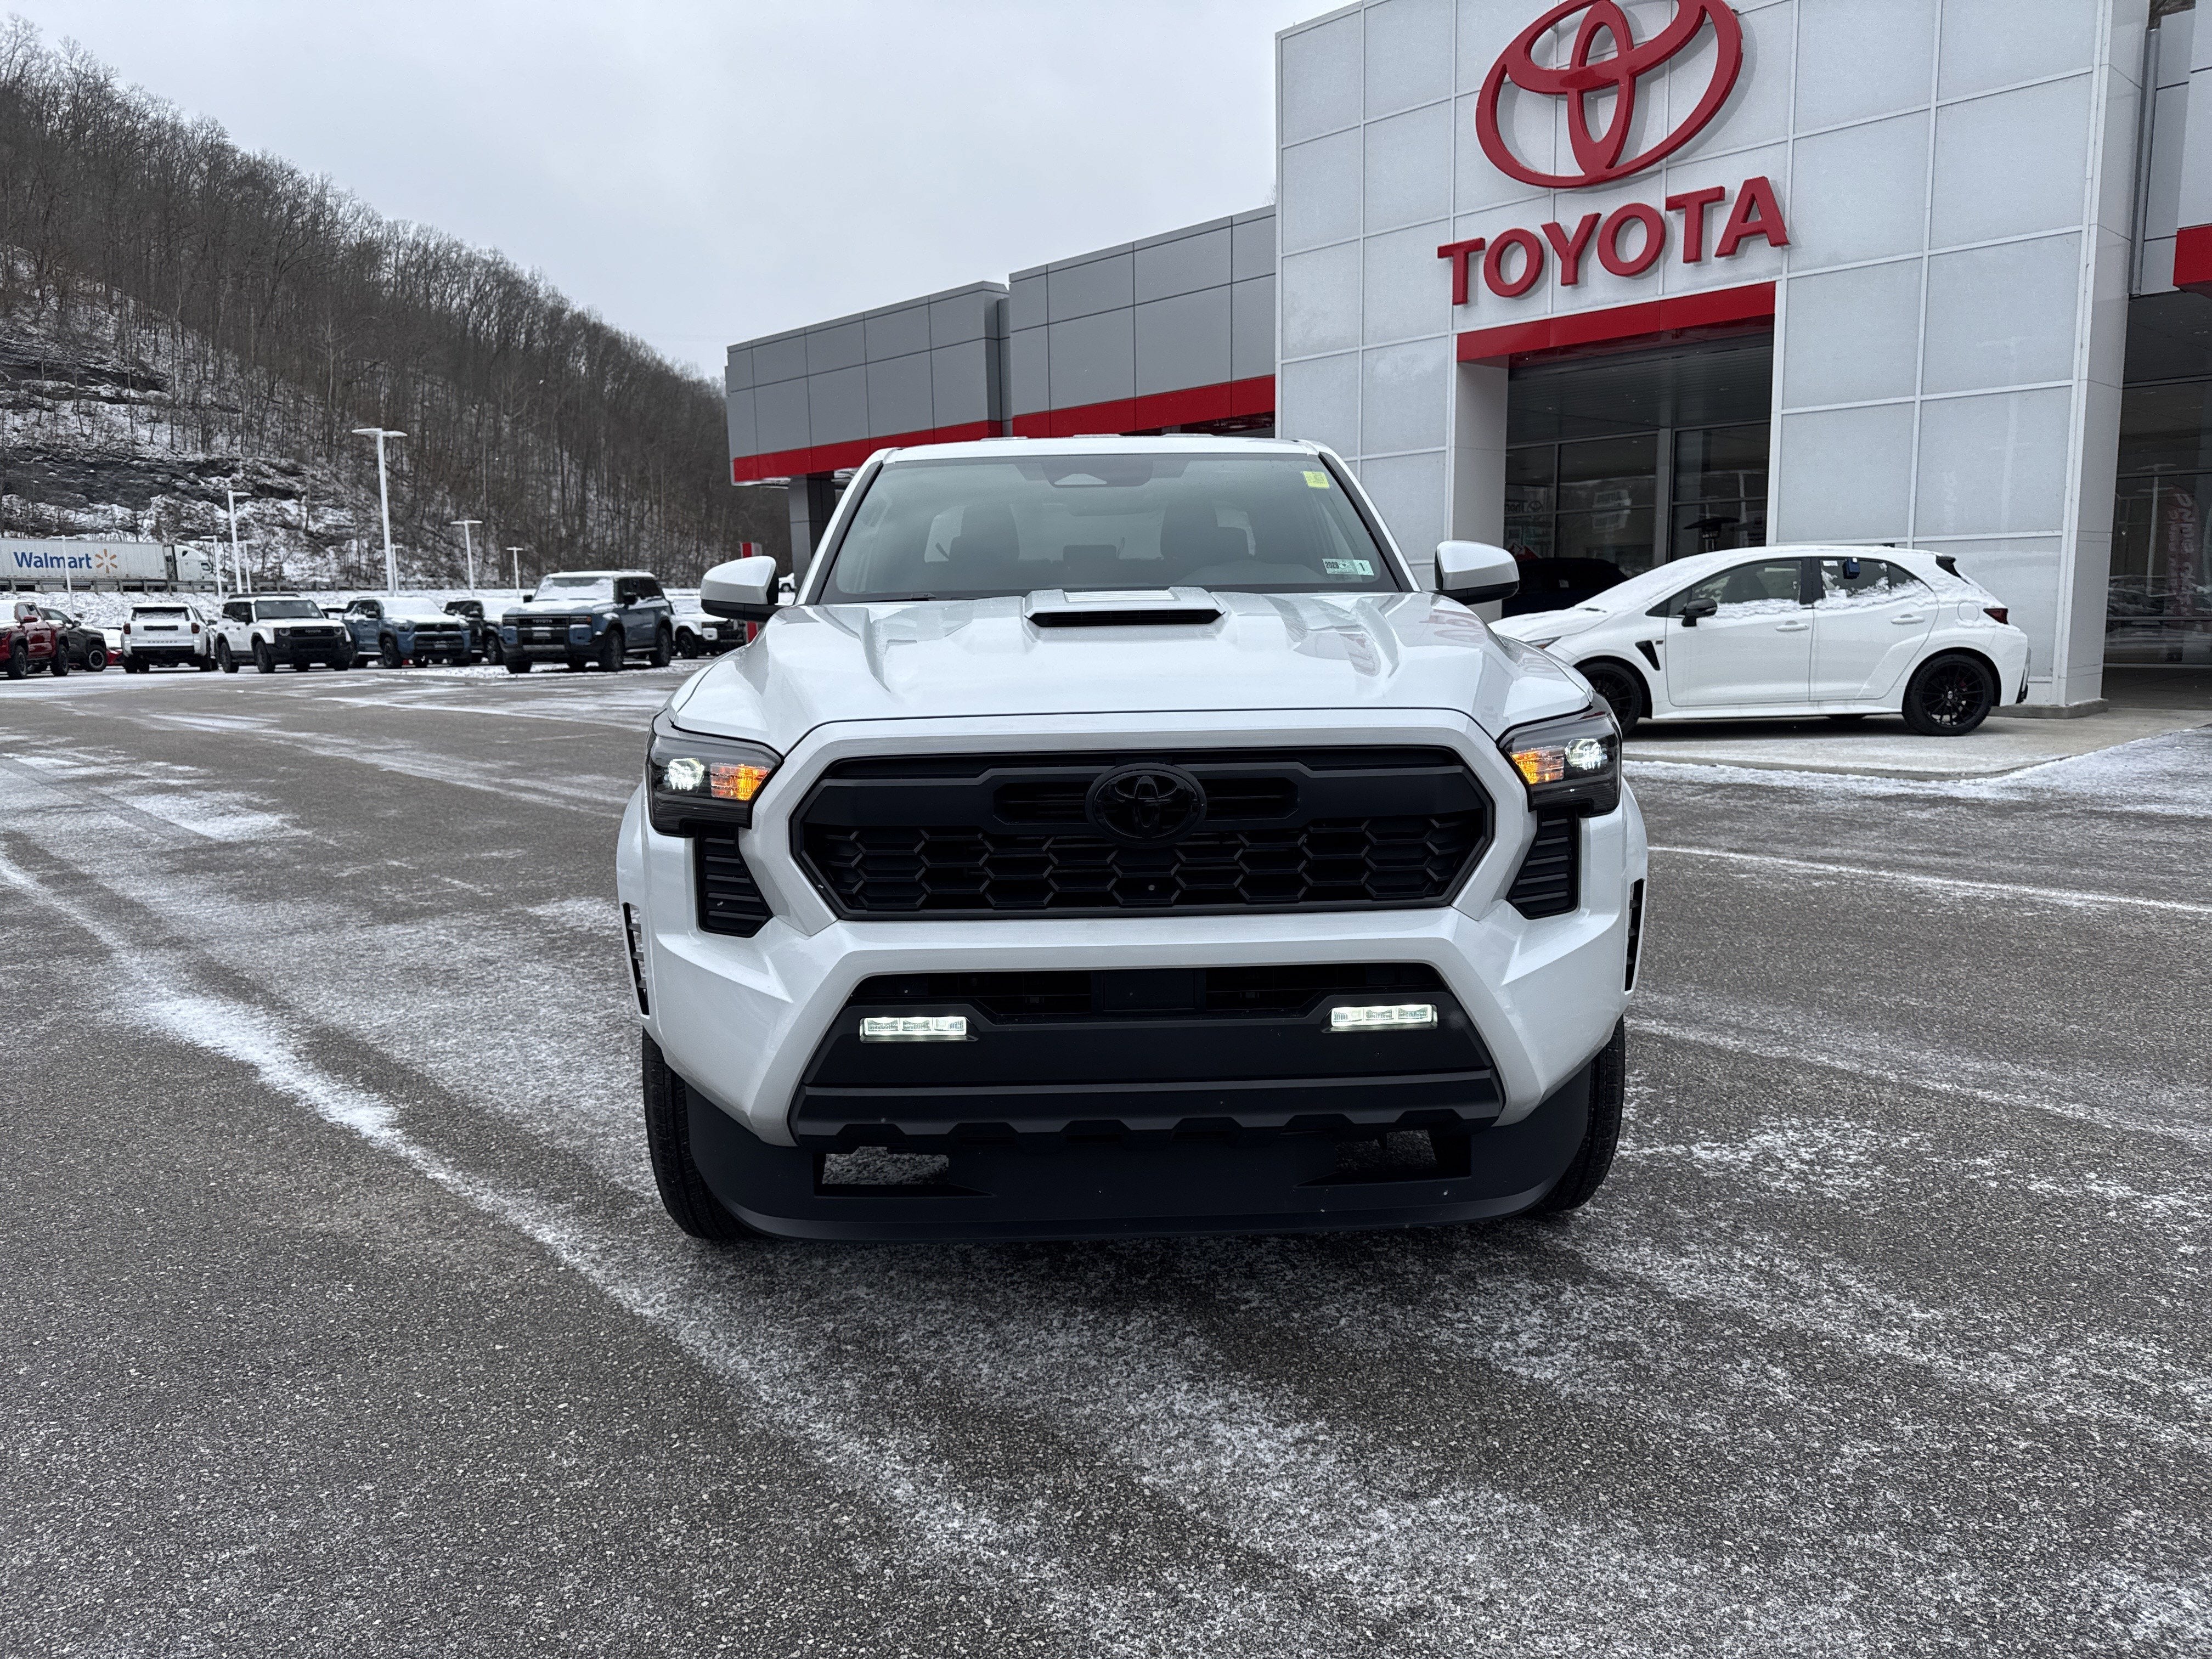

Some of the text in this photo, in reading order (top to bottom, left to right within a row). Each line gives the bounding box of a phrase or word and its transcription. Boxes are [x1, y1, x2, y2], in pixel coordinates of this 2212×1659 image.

[1437, 176, 1791, 306] TOYOTA
[13, 552, 92, 569] Walmart
[1359, 562, 1365, 571] 1
